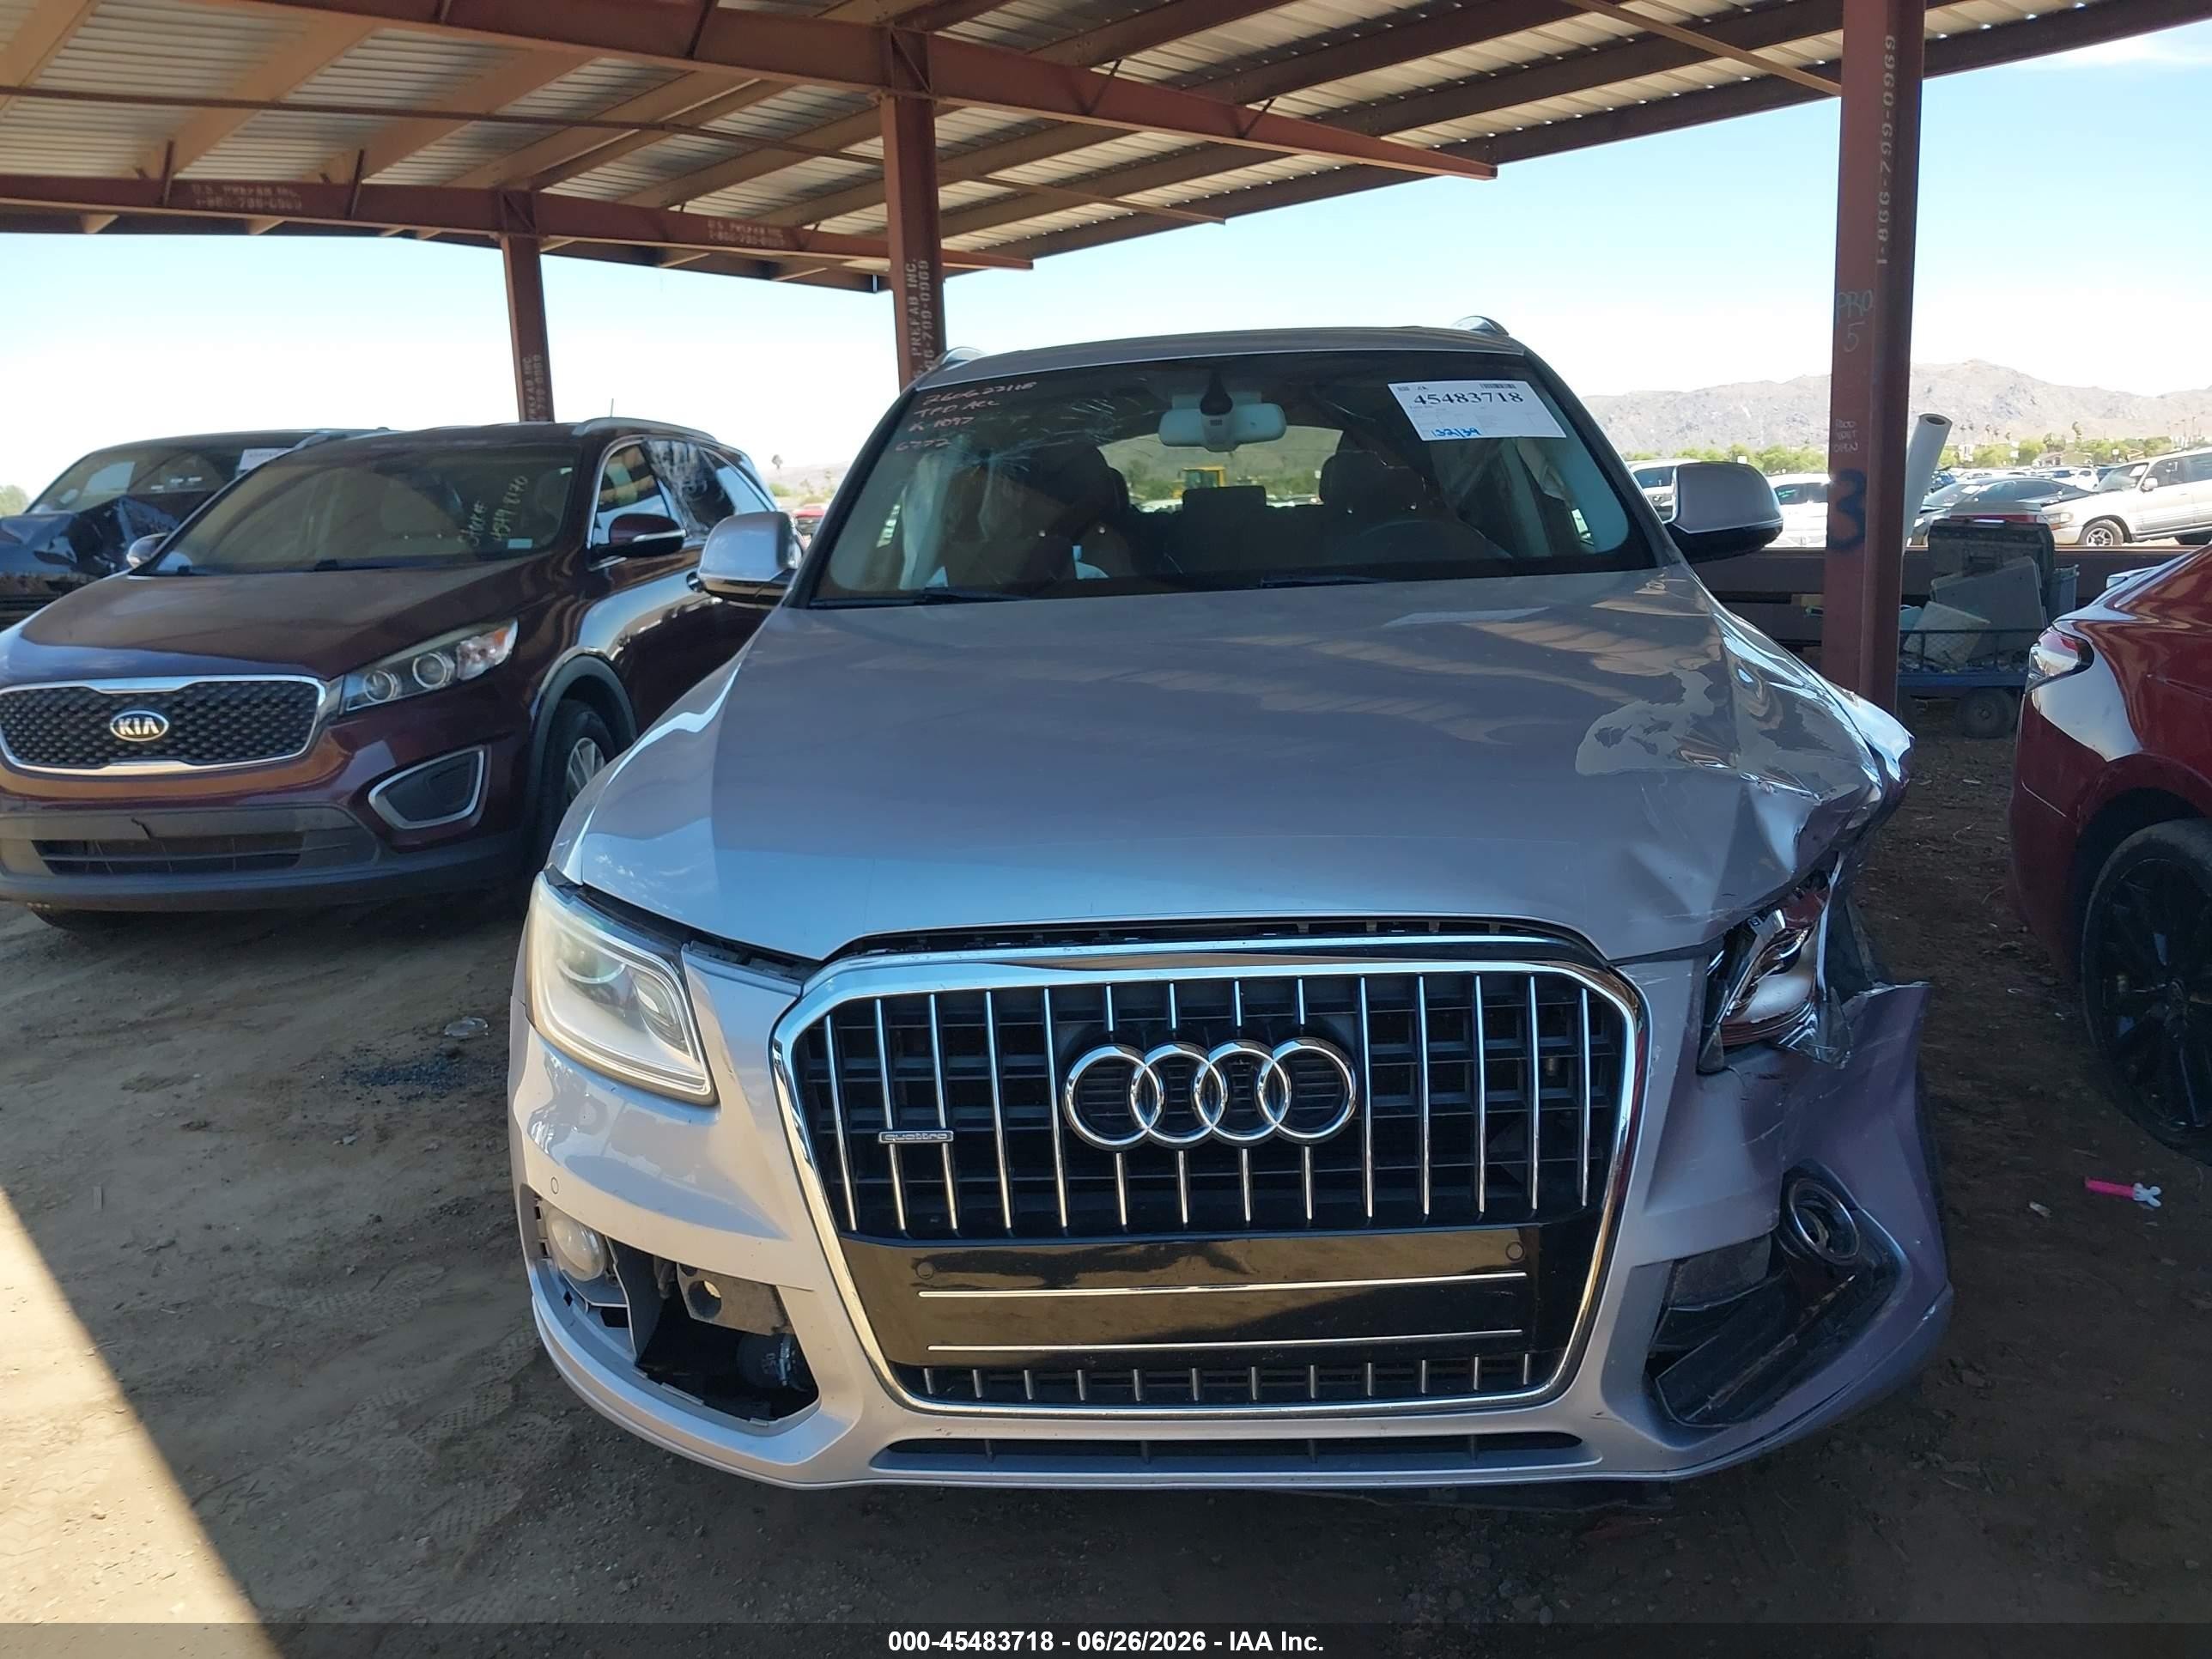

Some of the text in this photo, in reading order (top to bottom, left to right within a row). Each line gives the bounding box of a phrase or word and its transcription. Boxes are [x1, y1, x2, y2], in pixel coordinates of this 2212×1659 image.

[1876, 34, 1896, 264] 1-866-799-0969
[906, 258, 918, 289] INC.
[908, 295, 922, 357] PREFAB
[1413, 392, 1524, 405] 45483718
[1827, 468, 1866, 550] 3
[118, 717, 160, 736] KIA
[885, 1133, 948, 1142] quattro
